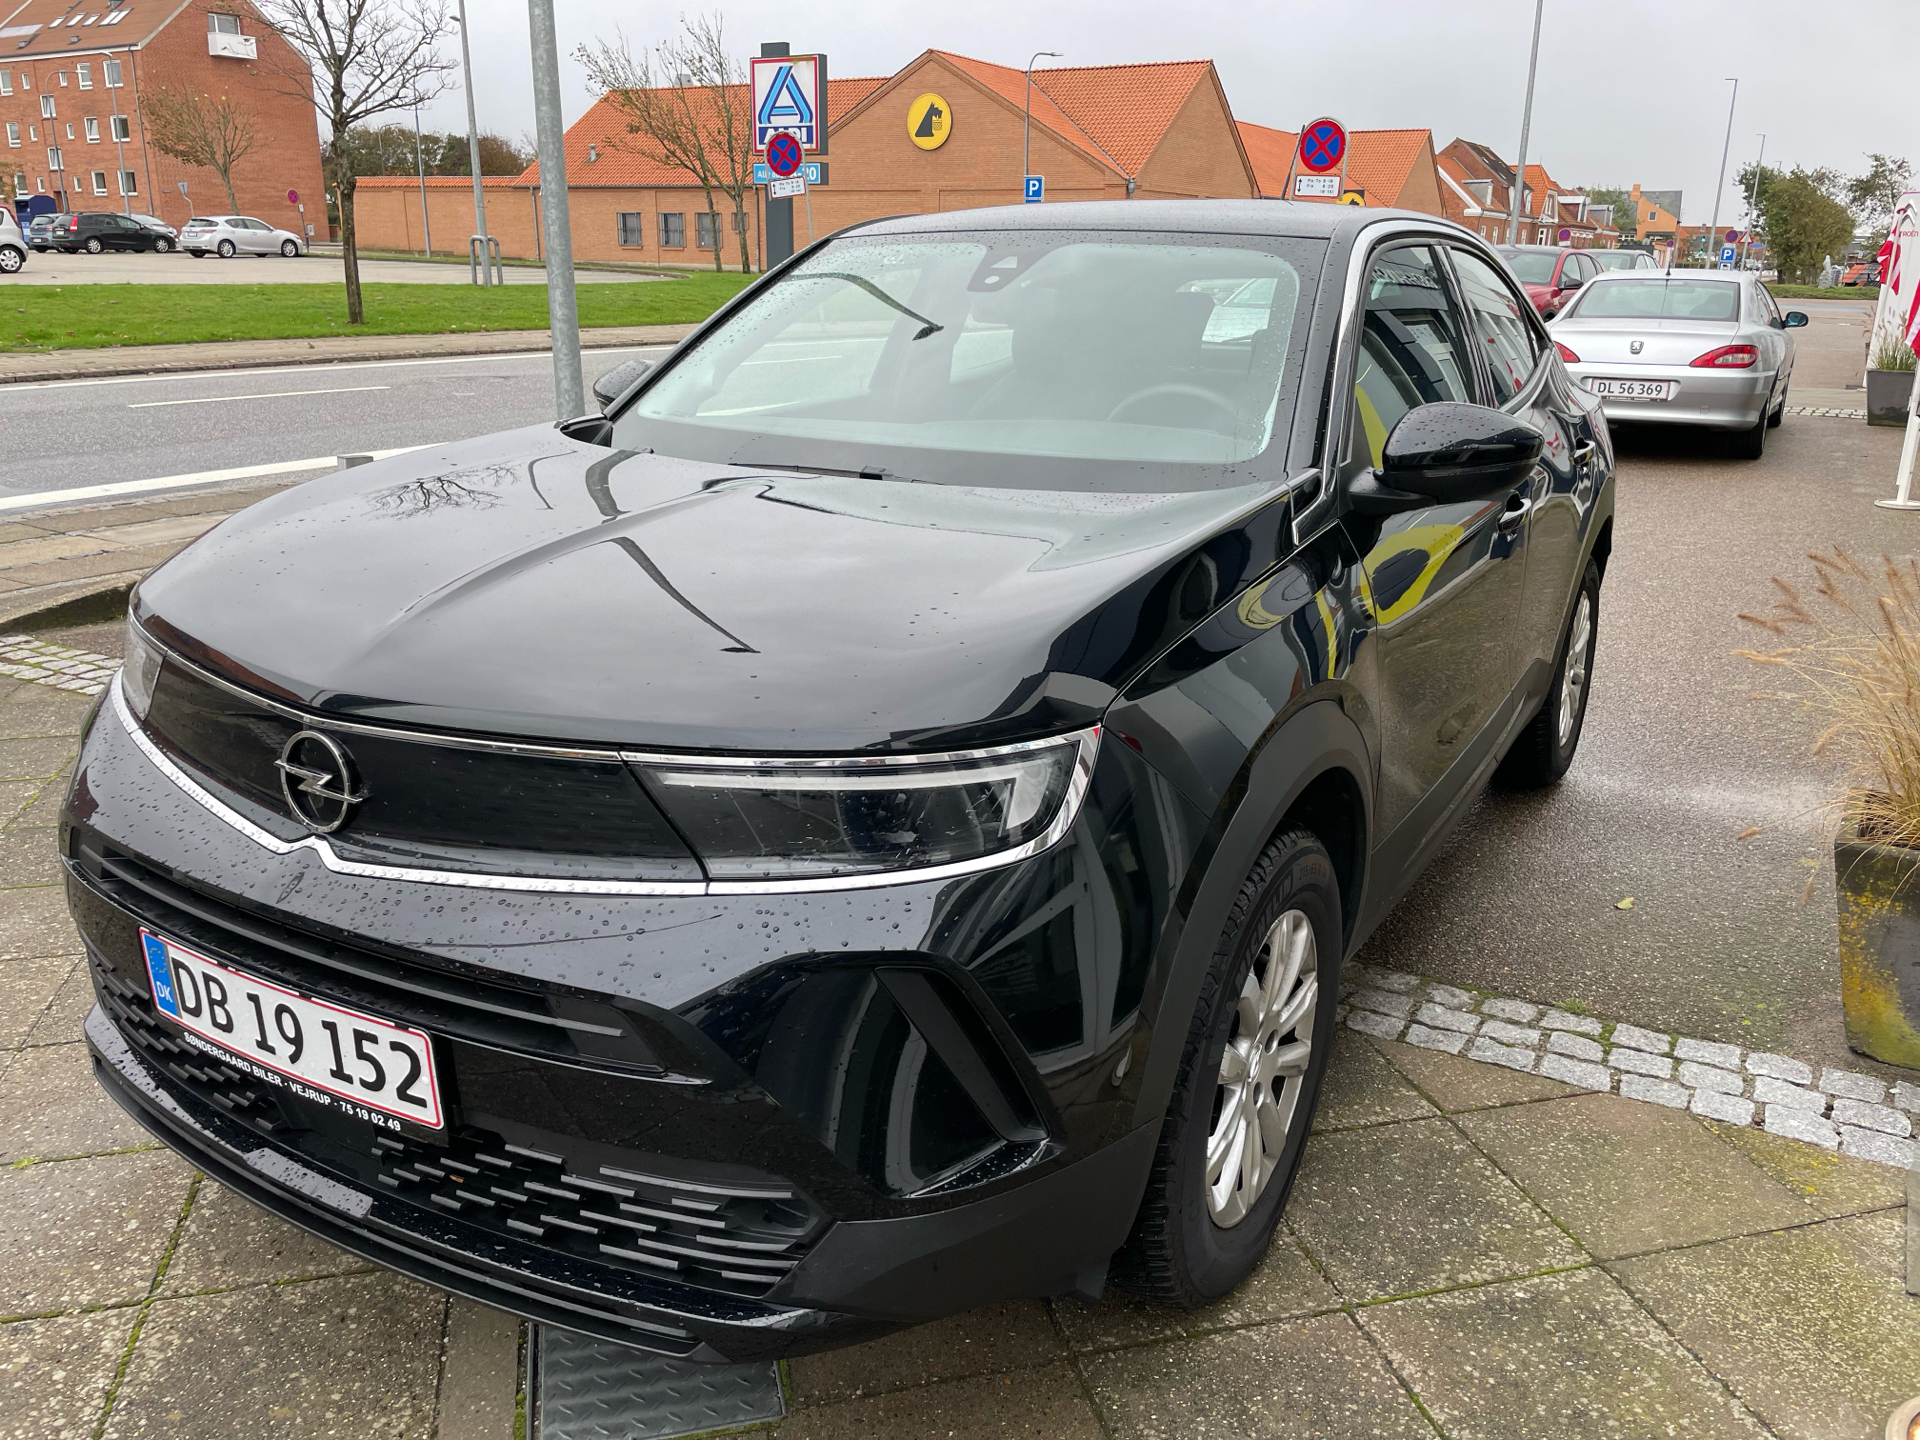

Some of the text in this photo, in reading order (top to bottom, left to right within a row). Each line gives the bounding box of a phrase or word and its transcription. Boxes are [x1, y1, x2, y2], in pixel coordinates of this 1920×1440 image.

[1029, 180, 1040, 196] P
[1723, 249, 1732, 259] P
[1597, 382, 1663, 396] DL 56 369
[156, 980, 173, 1003] DK
[170, 956, 428, 1109] DB 19 152
[183, 1031, 401, 1131] SØNDERGAARD BILER VEJRUP 75 19 02 49
